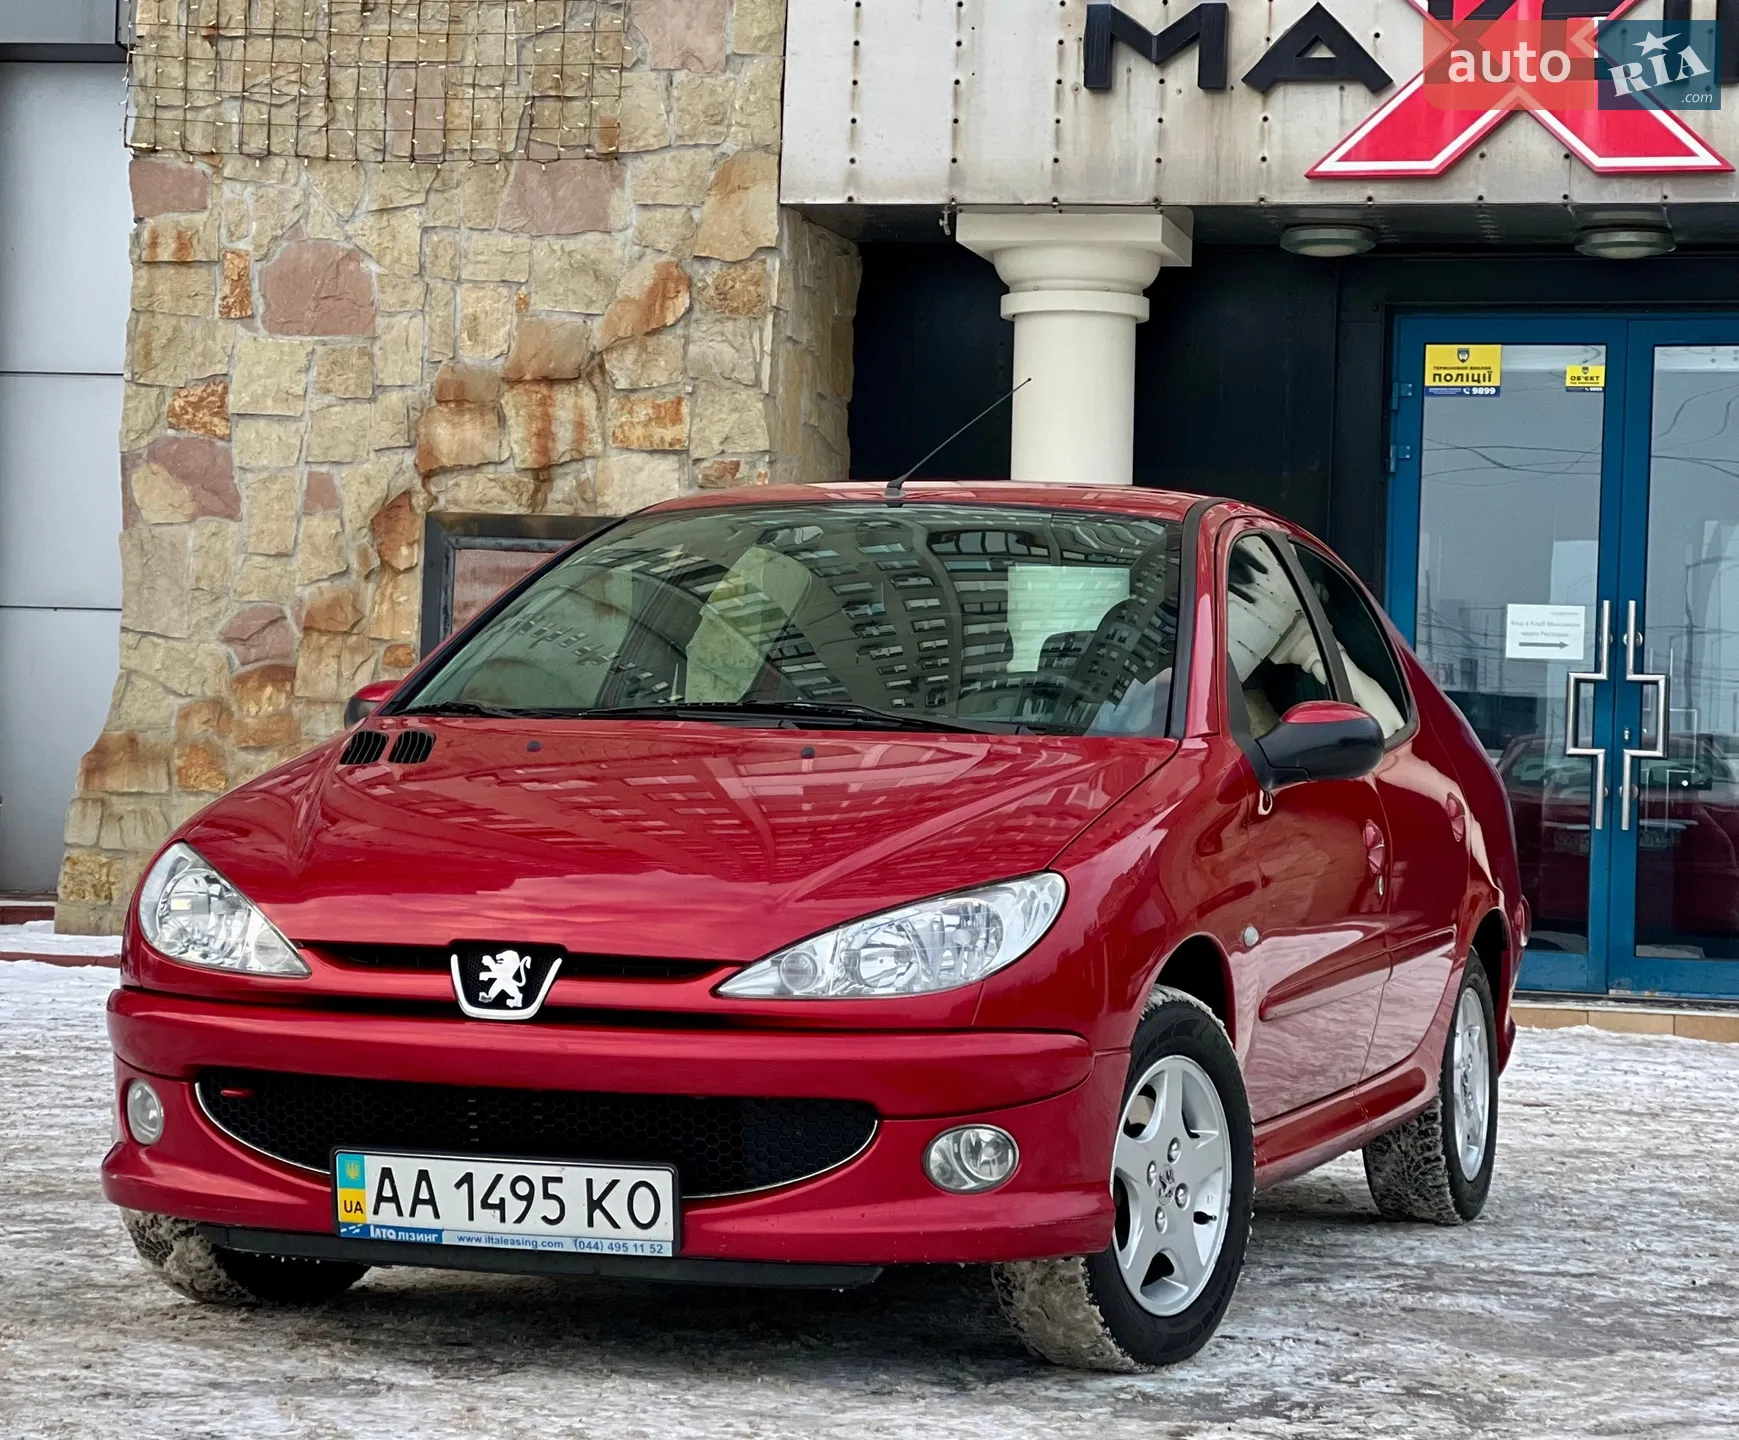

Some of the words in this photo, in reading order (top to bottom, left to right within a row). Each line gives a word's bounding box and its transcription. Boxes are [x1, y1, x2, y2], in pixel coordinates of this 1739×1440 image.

[1433, 371, 1493, 384] ПОЛІЦІЇ
[1472, 387, 1496, 395] 9899
[371, 1166, 441, 1219] AA
[453, 1171, 566, 1226] 1495
[585, 1177, 661, 1231] KO
[343, 1199, 364, 1215] UA
[457, 1235, 564, 1250] www.iltaleasing.com
[573, 1238, 604, 1252] (044)
[607, 1243, 629, 1252] 495
[633, 1243, 645, 1253] 11
[650, 1244, 664, 1254] 52
